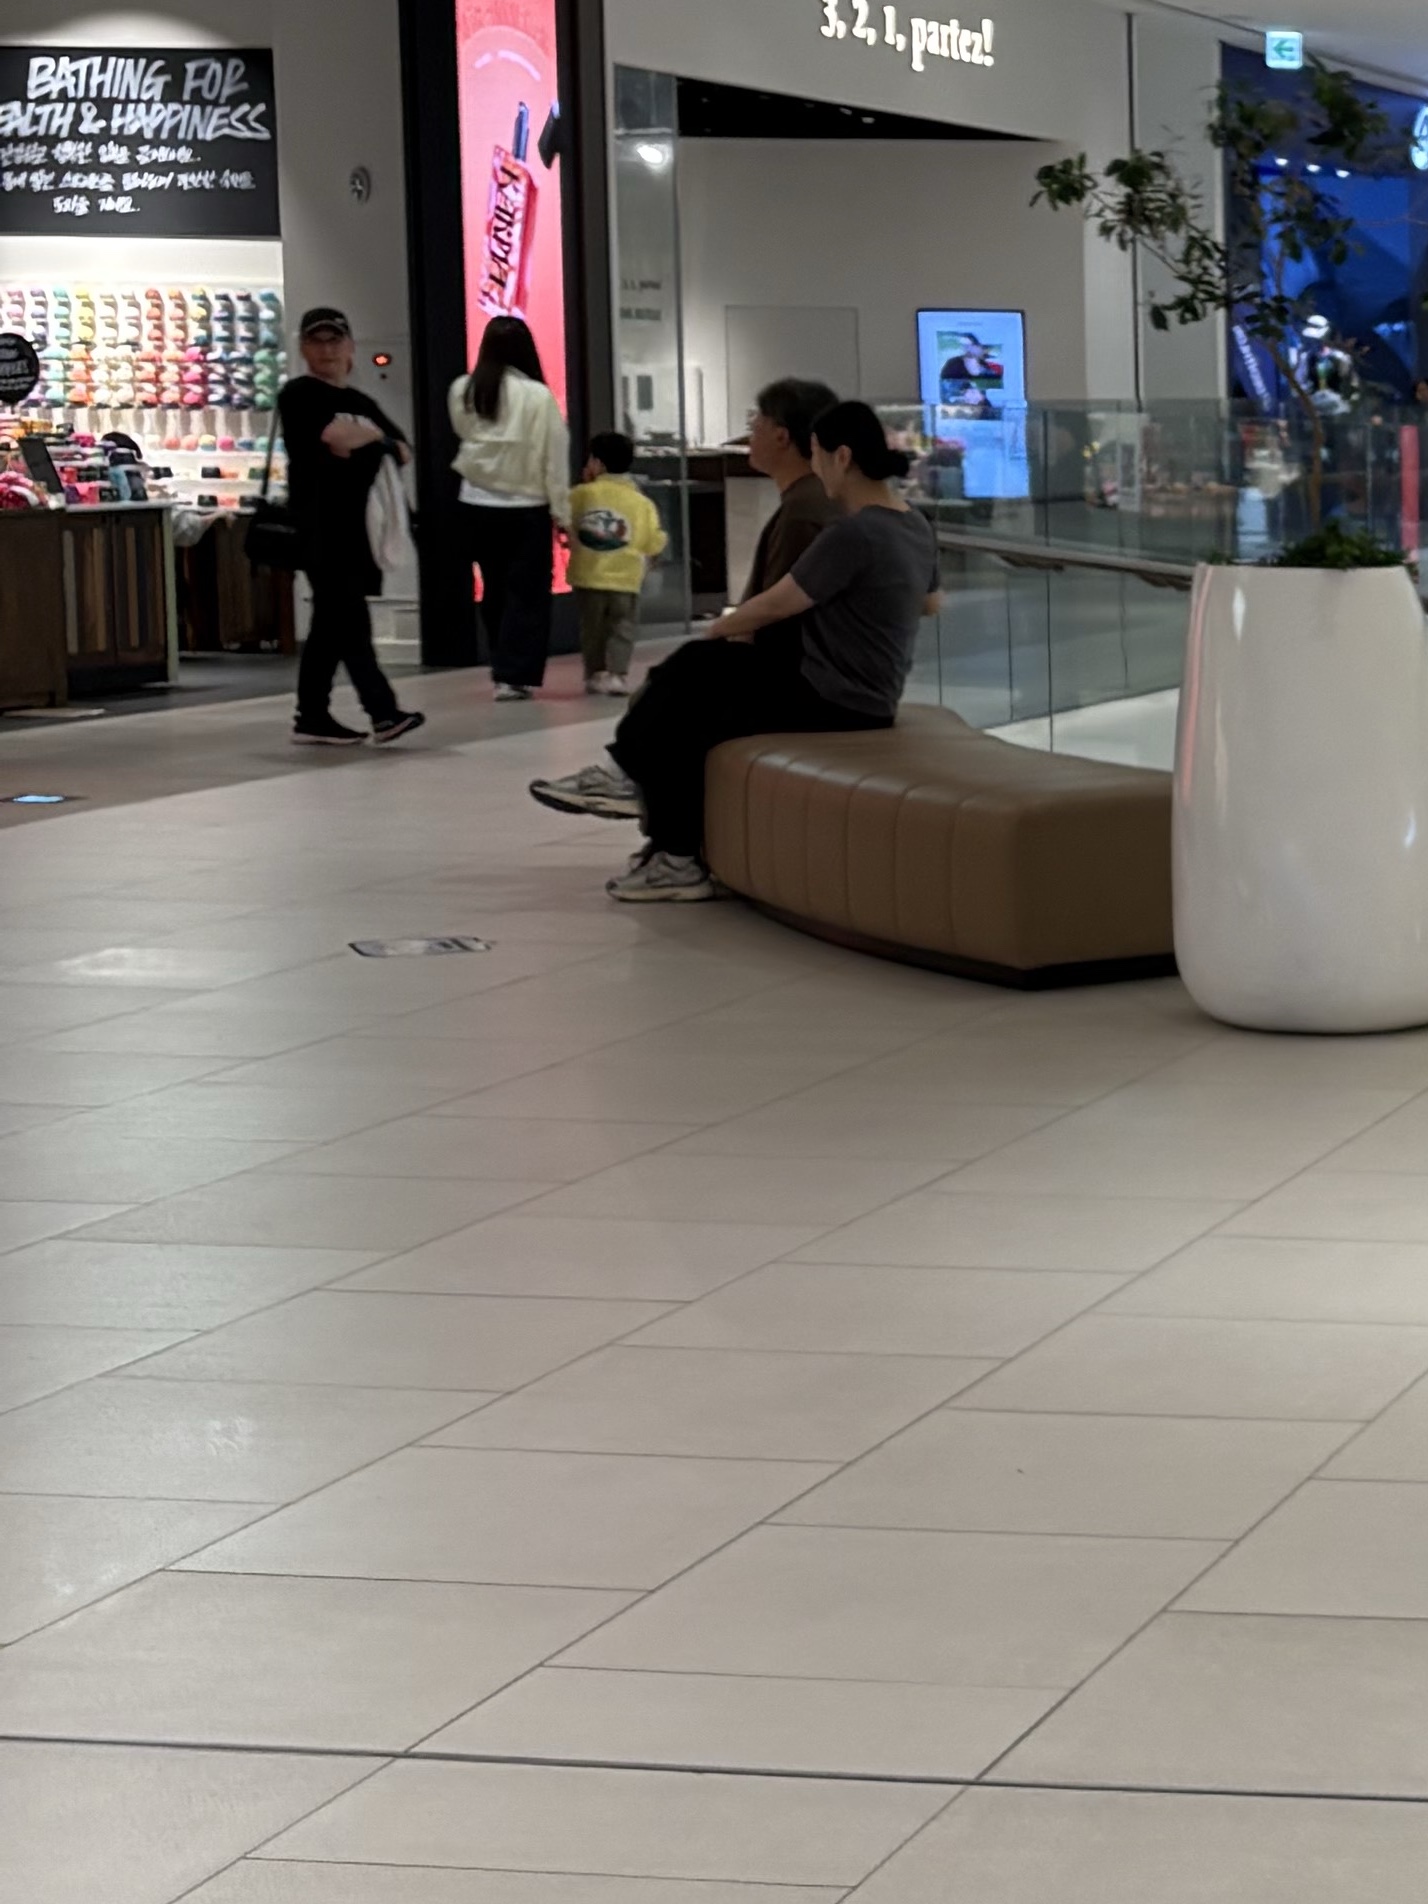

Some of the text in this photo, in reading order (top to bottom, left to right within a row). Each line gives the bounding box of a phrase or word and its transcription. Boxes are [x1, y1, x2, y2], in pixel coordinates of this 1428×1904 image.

[883, 5, 906, 52] 1,
[910, 17, 995, 72] partez!
[26, 56, 249, 104] BATHING FOR
[110, 102, 272, 142] HAPPINESS
